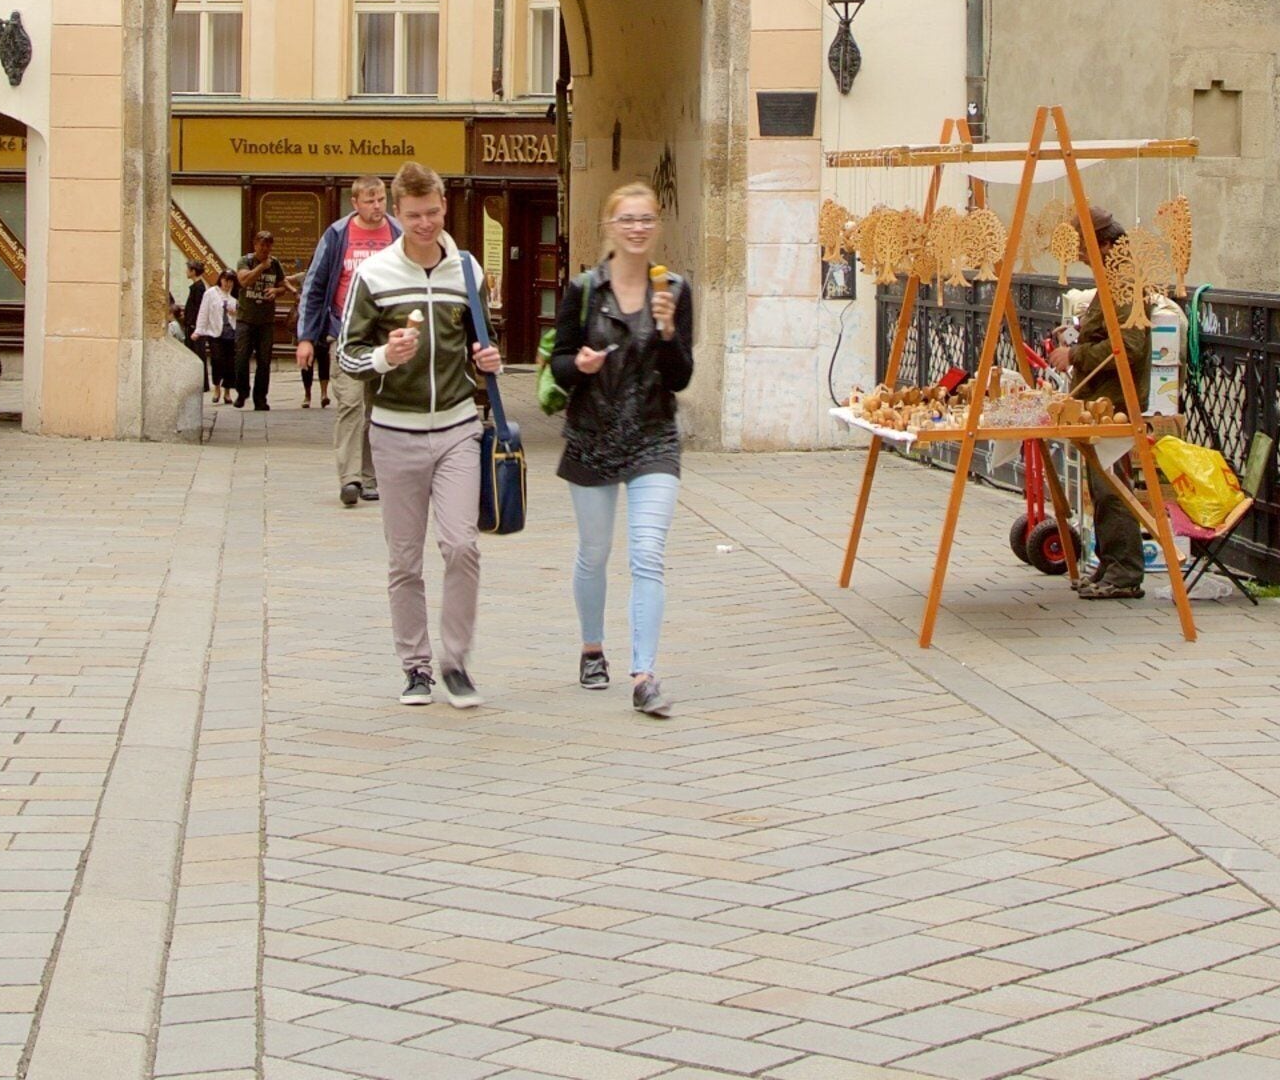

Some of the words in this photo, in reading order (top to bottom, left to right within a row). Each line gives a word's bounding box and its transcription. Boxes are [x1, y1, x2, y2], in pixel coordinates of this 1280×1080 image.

[230, 137, 303, 155] Vinotéka
[308, 144, 319, 155] u
[324, 144, 343, 156] sv.
[349, 138, 415, 157] Michala
